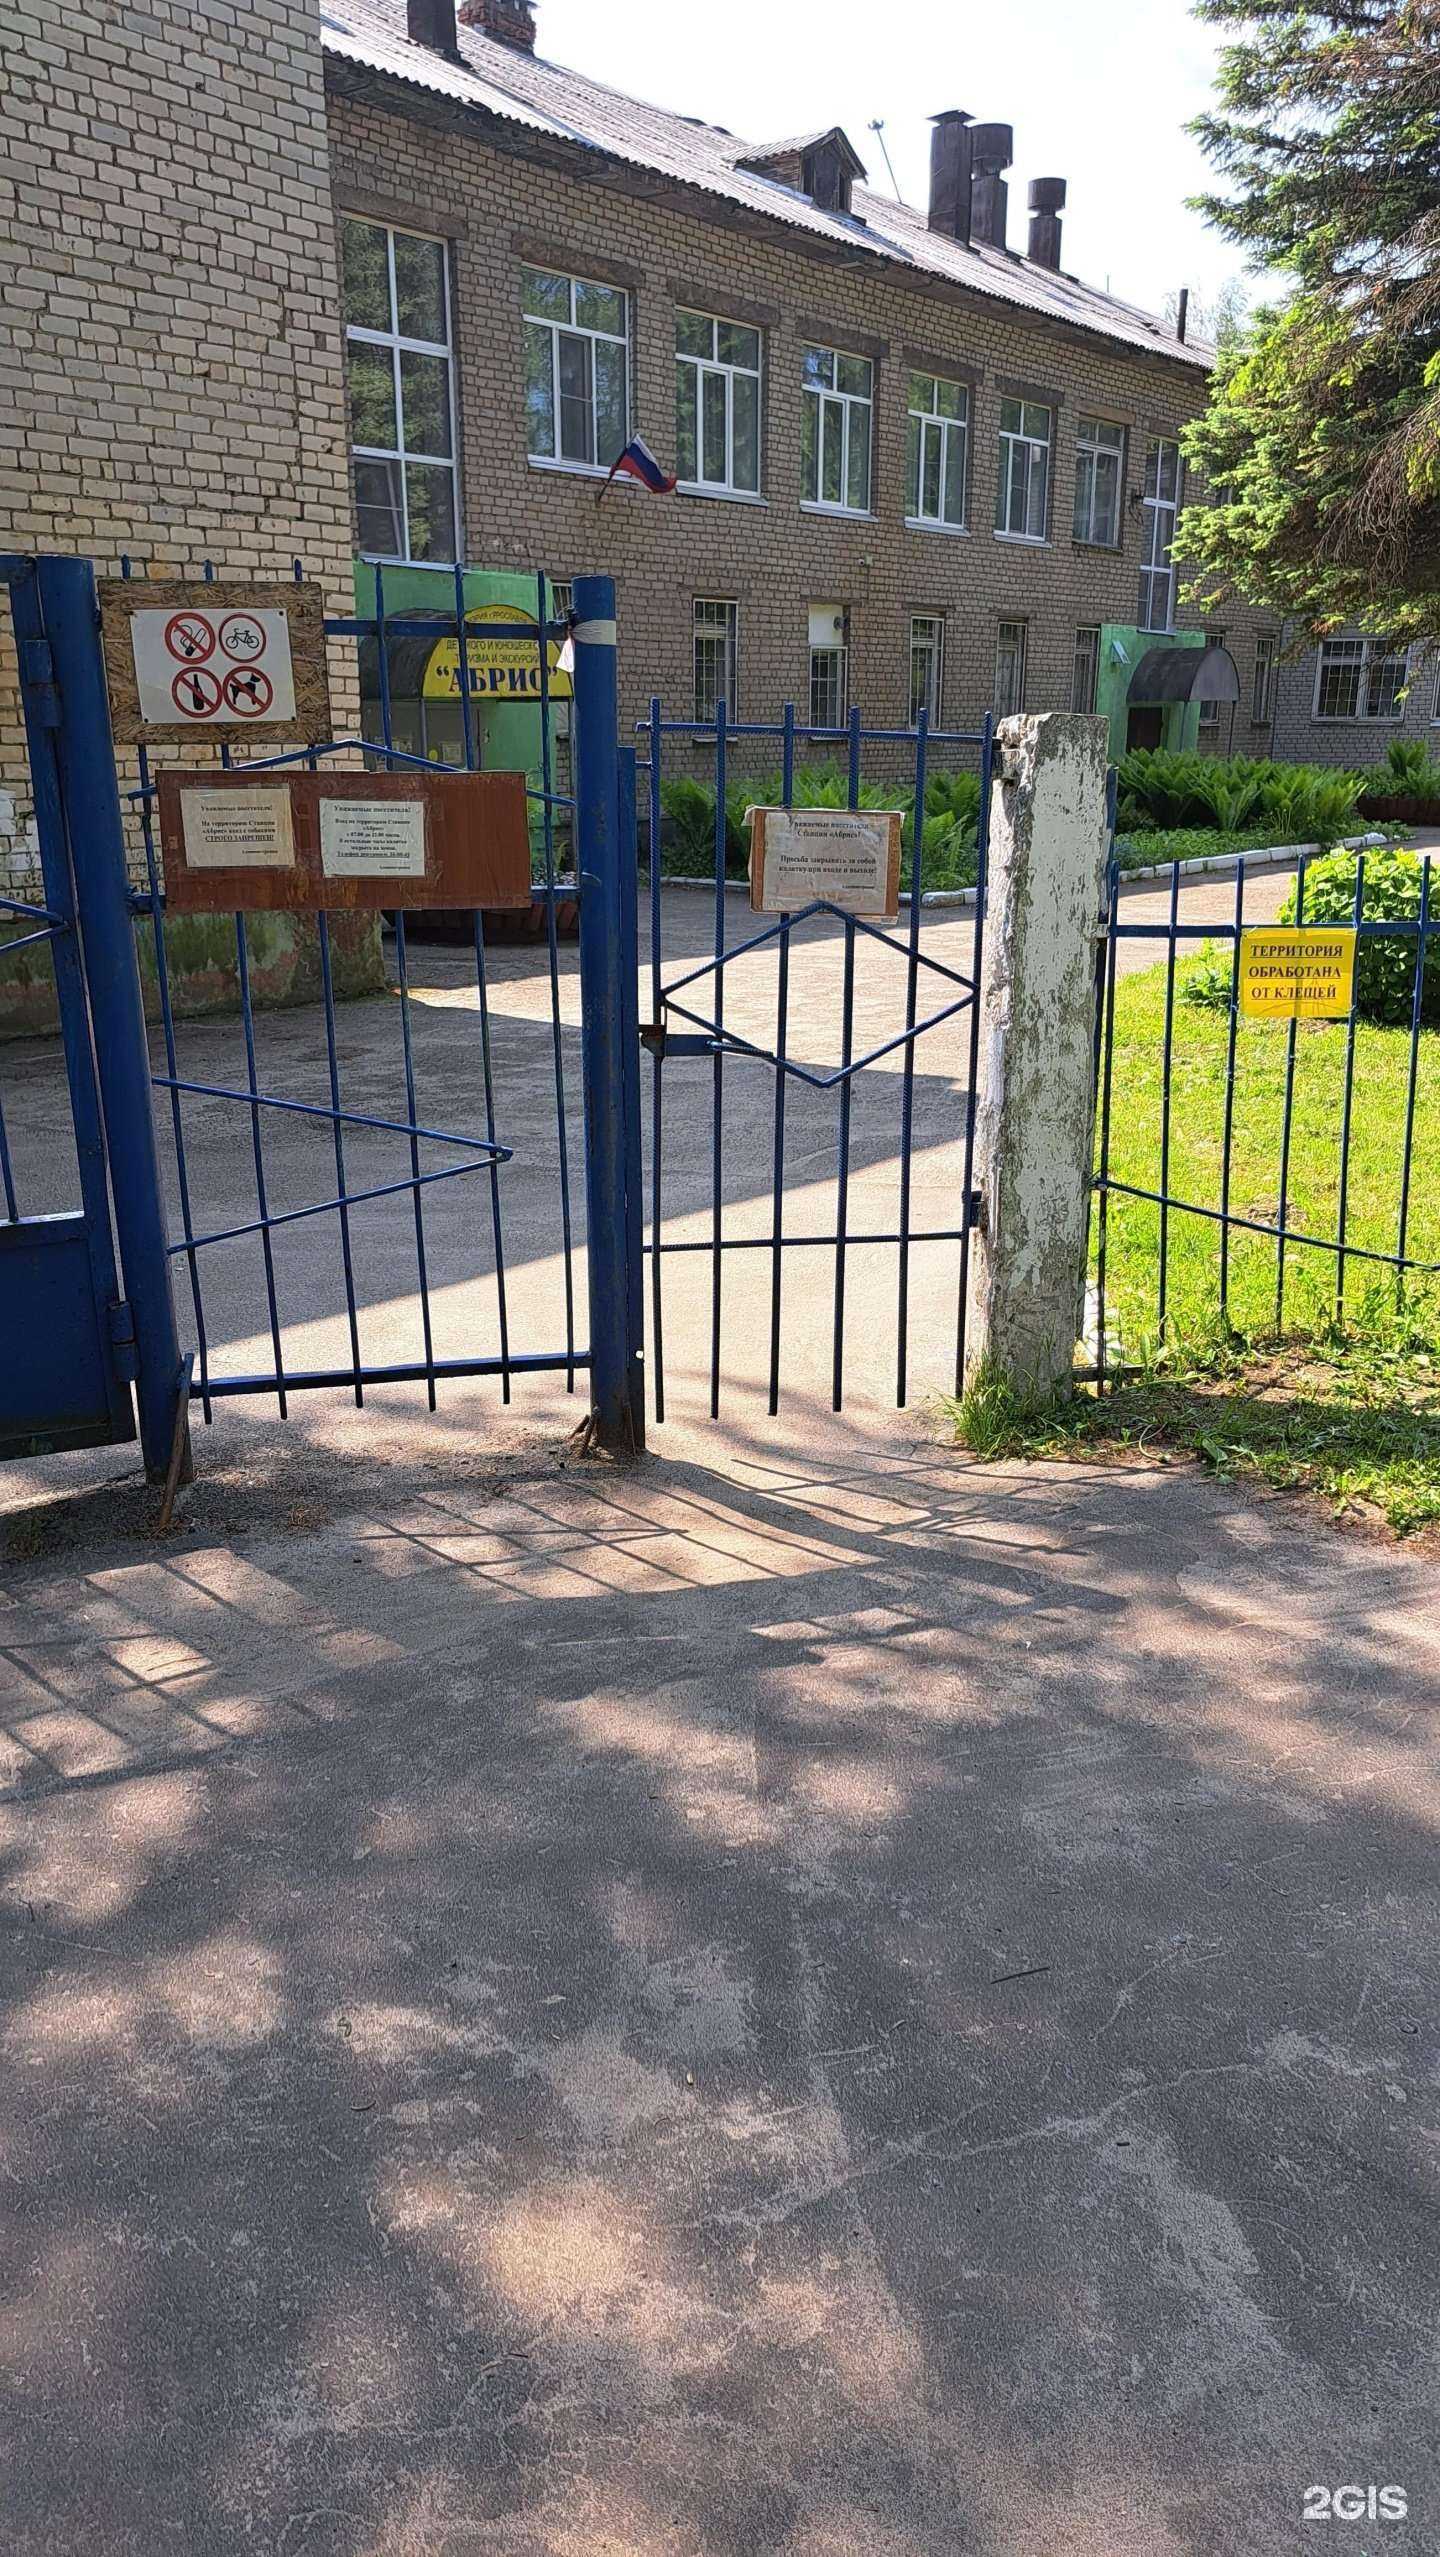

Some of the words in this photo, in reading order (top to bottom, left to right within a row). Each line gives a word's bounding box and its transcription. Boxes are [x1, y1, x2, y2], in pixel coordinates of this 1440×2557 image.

[446, 639, 486, 650] ДЕКОГО
[1250, 945, 1343, 957] ТЕРРИТОРИЯ
[1248, 966, 1341, 978] ОБРАБОТАНА
[1251, 987, 1271, 999] ОТ
[1274, 984, 1337, 1000] КЛЕЩЕЙ
